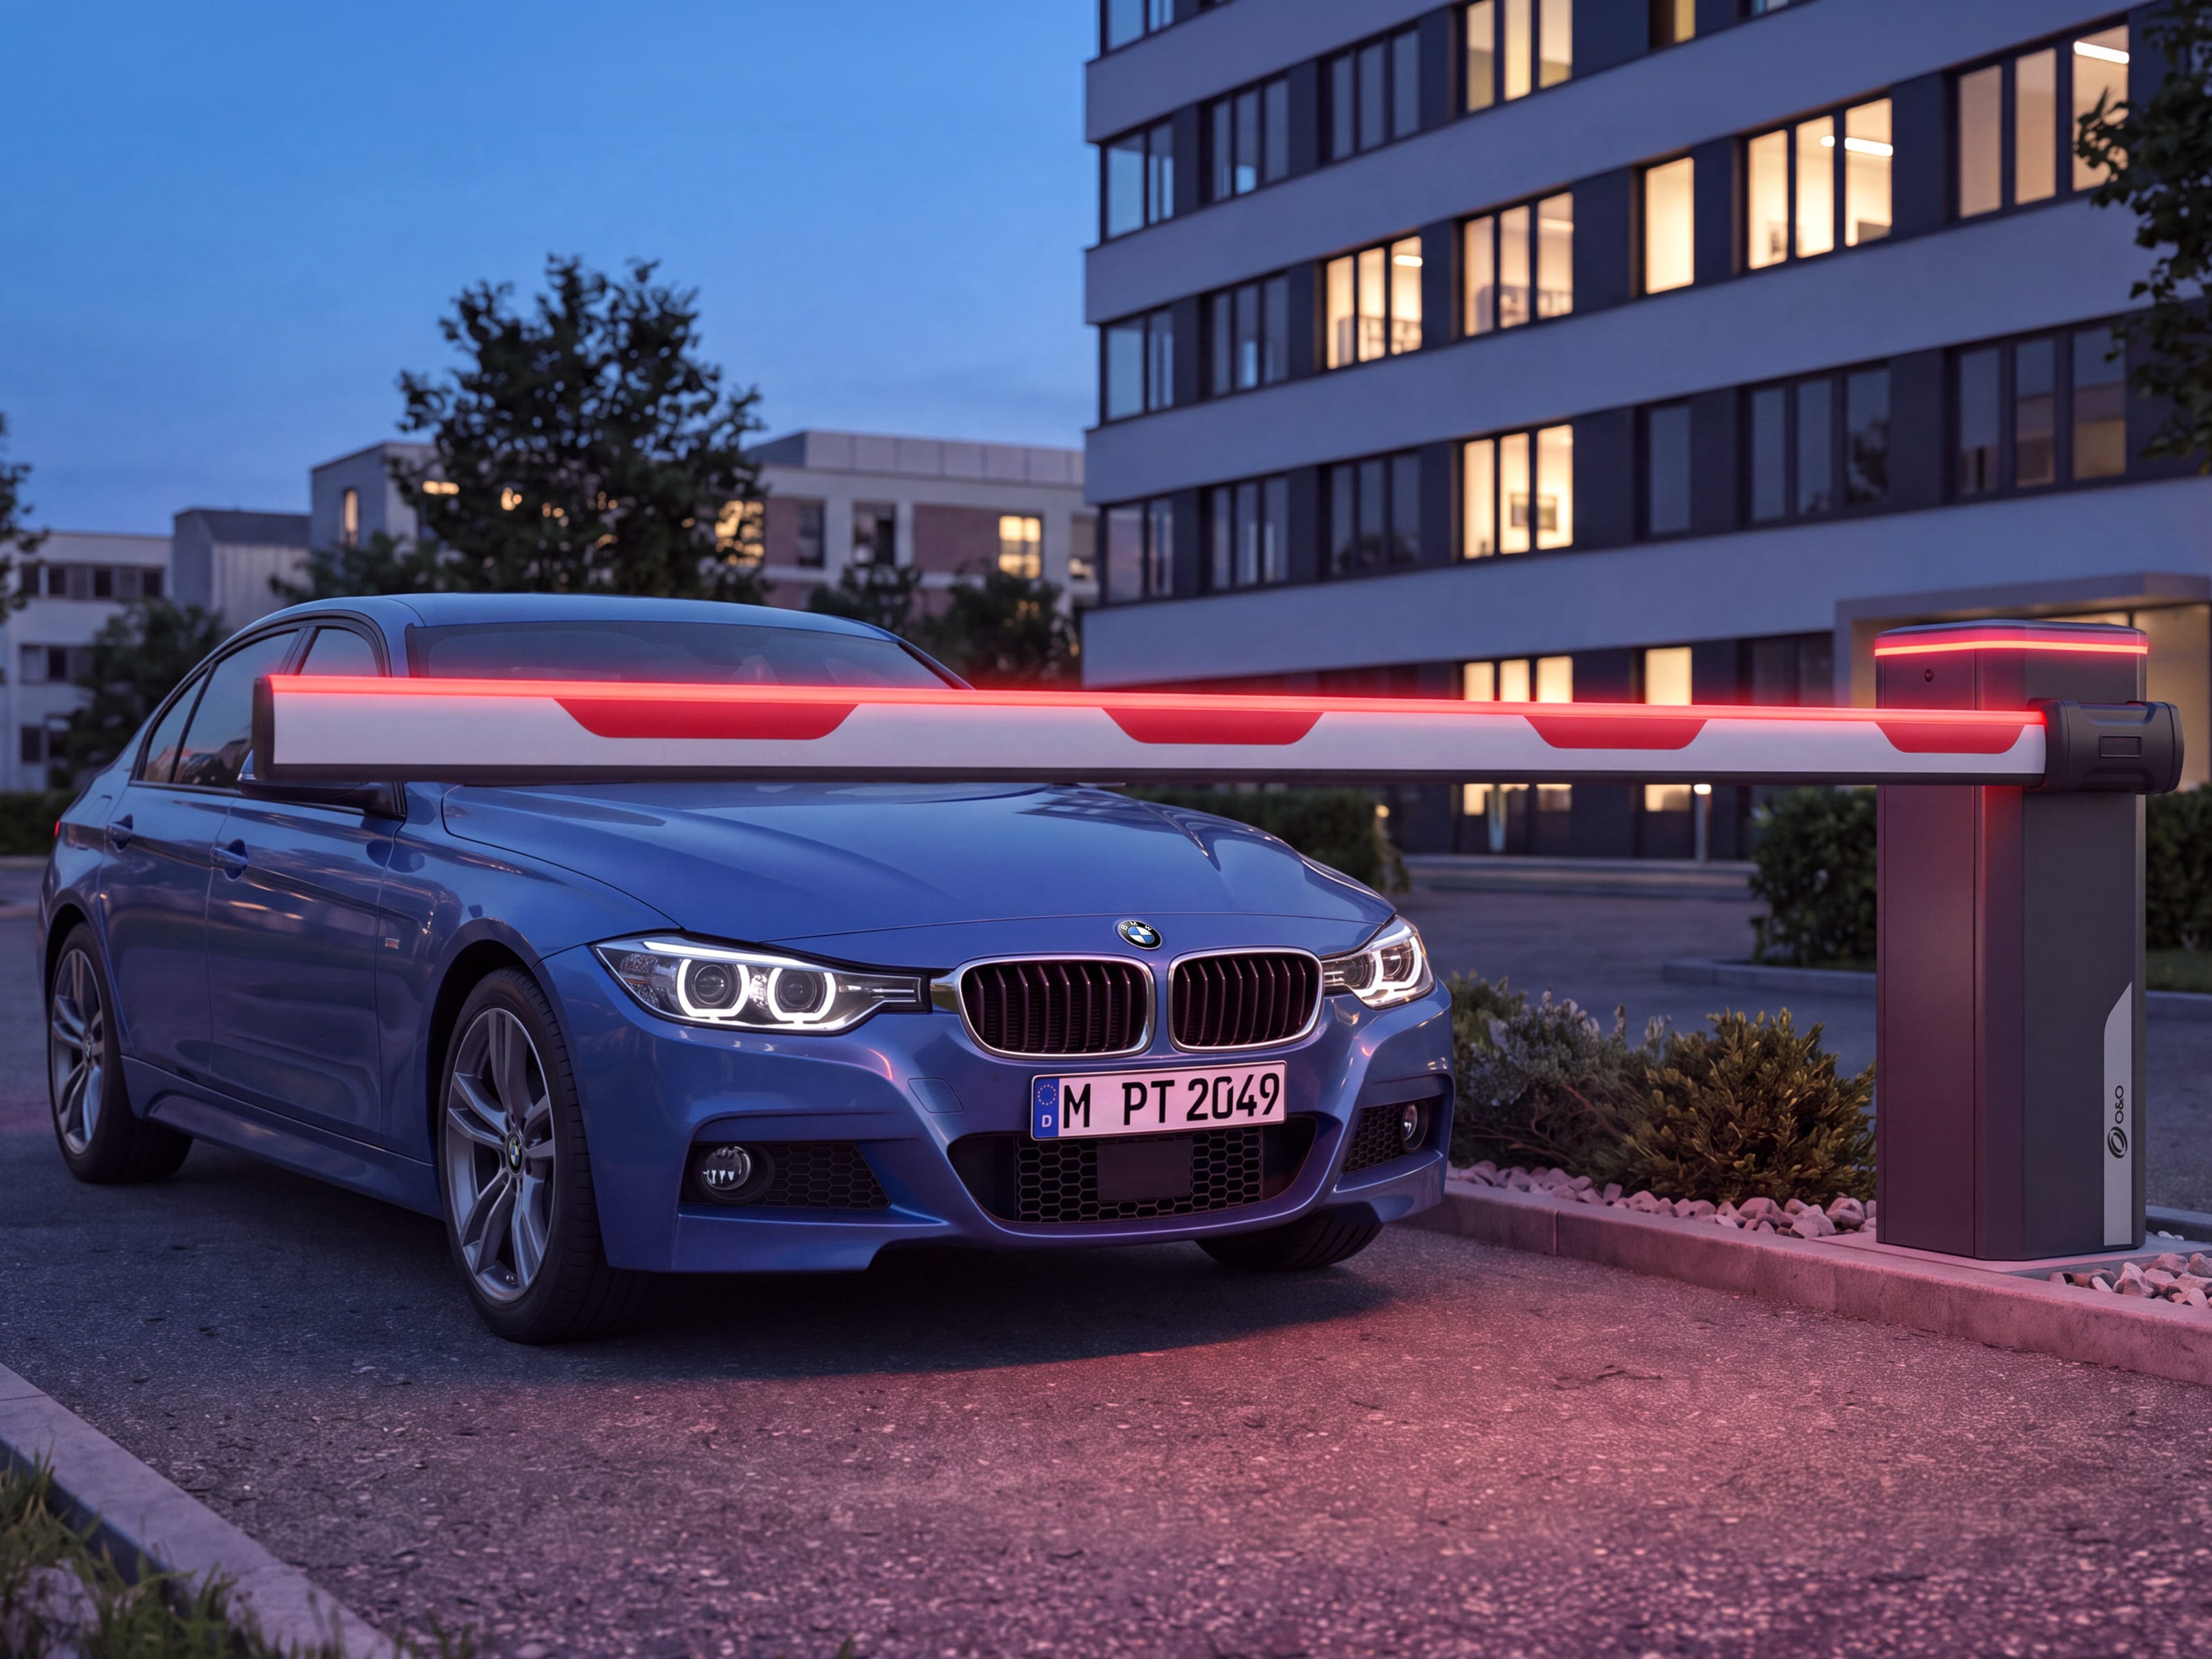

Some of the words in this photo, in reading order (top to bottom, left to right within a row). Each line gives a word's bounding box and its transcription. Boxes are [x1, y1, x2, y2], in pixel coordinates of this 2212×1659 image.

[1121, 921, 1152, 930] BMW
[1063, 1083, 1091, 1129] M
[1122, 1080, 1175, 1125] PT
[1186, 1072, 1280, 1121] 2049
[2115, 1085, 2124, 1124] O&O
[1042, 1115, 1051, 1128] D
